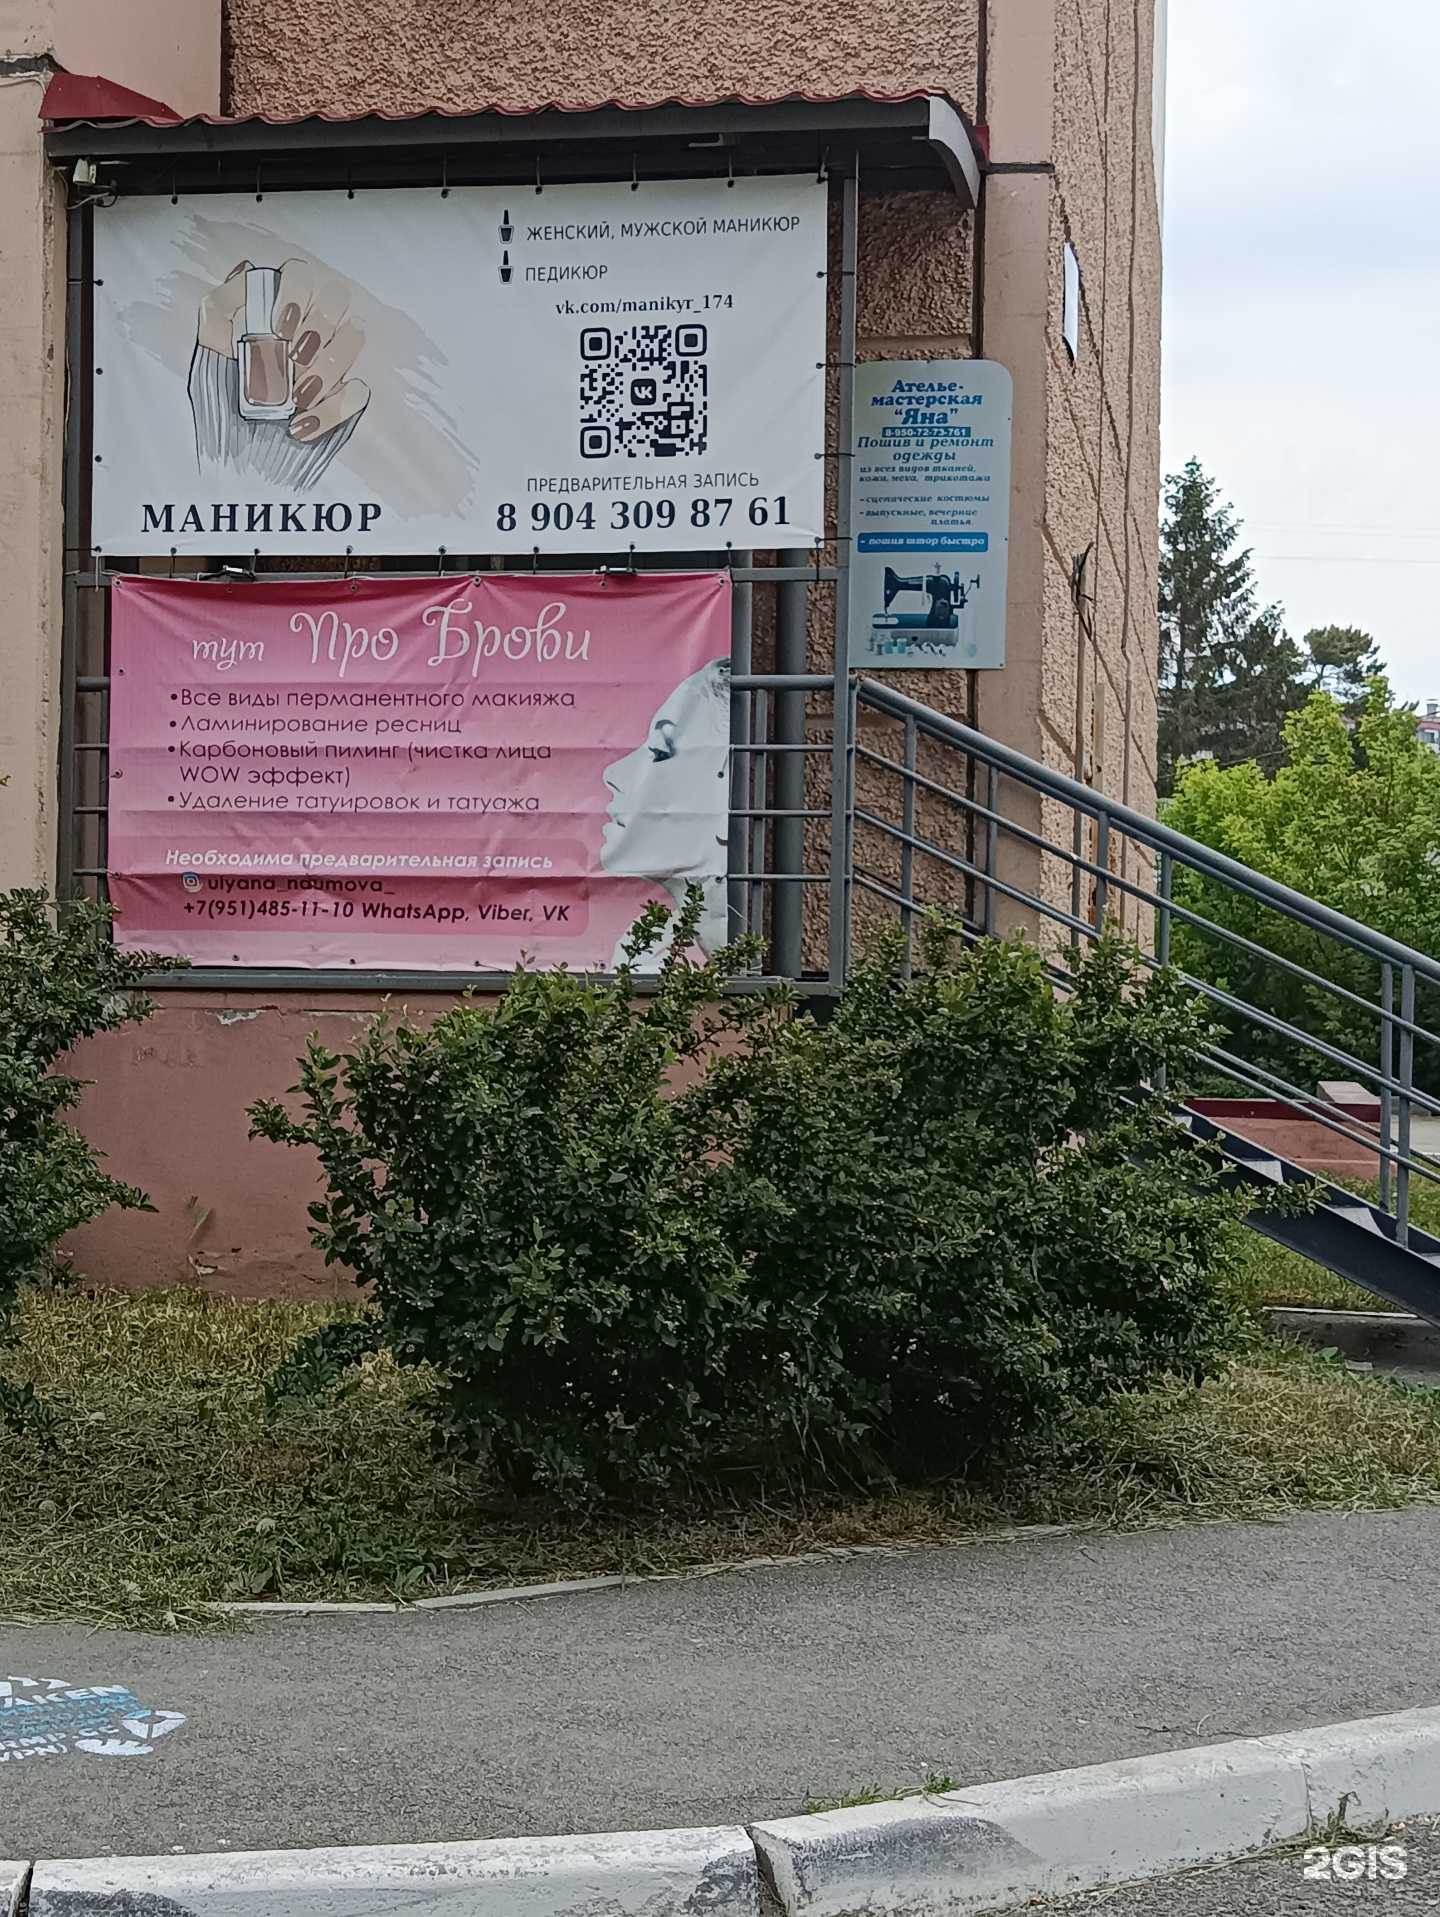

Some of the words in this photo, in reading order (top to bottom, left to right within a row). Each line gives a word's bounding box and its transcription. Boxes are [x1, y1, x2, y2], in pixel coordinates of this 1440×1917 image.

[527, 221, 614, 241] ЖЕНСКИЙ,
[621, 217, 708, 238] МУЖСКОЙ
[712, 216, 800, 235] МАНИКЮР
[526, 265, 609, 283] ПЕДИКЮР
[555, 294, 734, 315] vk.com/manikyr_174
[891, 379, 964, 393] Ателье-
[871, 394, 983, 408] мастерская
[857, 436, 911, 448] Пошив
[916, 438, 925, 447] и
[929, 437, 994, 449] ремонт
[893, 451, 956, 464] одежды
[527, 474, 687, 494] ПРЕДВАРИТЕЛЬНАЯ
[693, 472, 759, 489] ЗАПИСЬ
[141, 503, 382, 533] МАНИКЮР
[496, 503, 517, 531] 8
[531, 502, 596, 530] 904
[610, 500, 676, 529] 309
[690, 498, 733, 528] 87
[748, 496, 791, 526] 61
[940, 535, 985, 546] быстро
[191, 637, 265, 671] тут
[289, 610, 399, 679] Про
[422, 598, 592, 678] Брови
[181, 688, 221, 706] Все
[228, 693, 280, 708] виды
[287, 692, 465, 710] перманентного
[471, 692, 575, 707] макияжа
[181, 715, 368, 735] Ламинирование
[375, 718, 462, 735] ресниц
[180, 740, 318, 761] Карбоновый
[325, 744, 400, 759] пилинг
[407, 741, 488, 762] (чистка
[495, 745, 551, 760] лица
[179, 765, 241, 784] WOW
[247, 766, 350, 788] эффект)
[179, 791, 289, 811] Удаление
[296, 795, 420, 814] татуировок
[427, 796, 440, 810] и
[448, 796, 540, 815] татуажа
[165, 849, 294, 867] Необходима
[299, 853, 477, 869] предварительная
[482, 855, 553, 869] запись
[184, 900, 354, 919] +7(951)485-11-10
[362, 902, 470, 923] WhatsApp,
[478, 903, 534, 923] Viber,
[543, 904, 571, 921] VK
